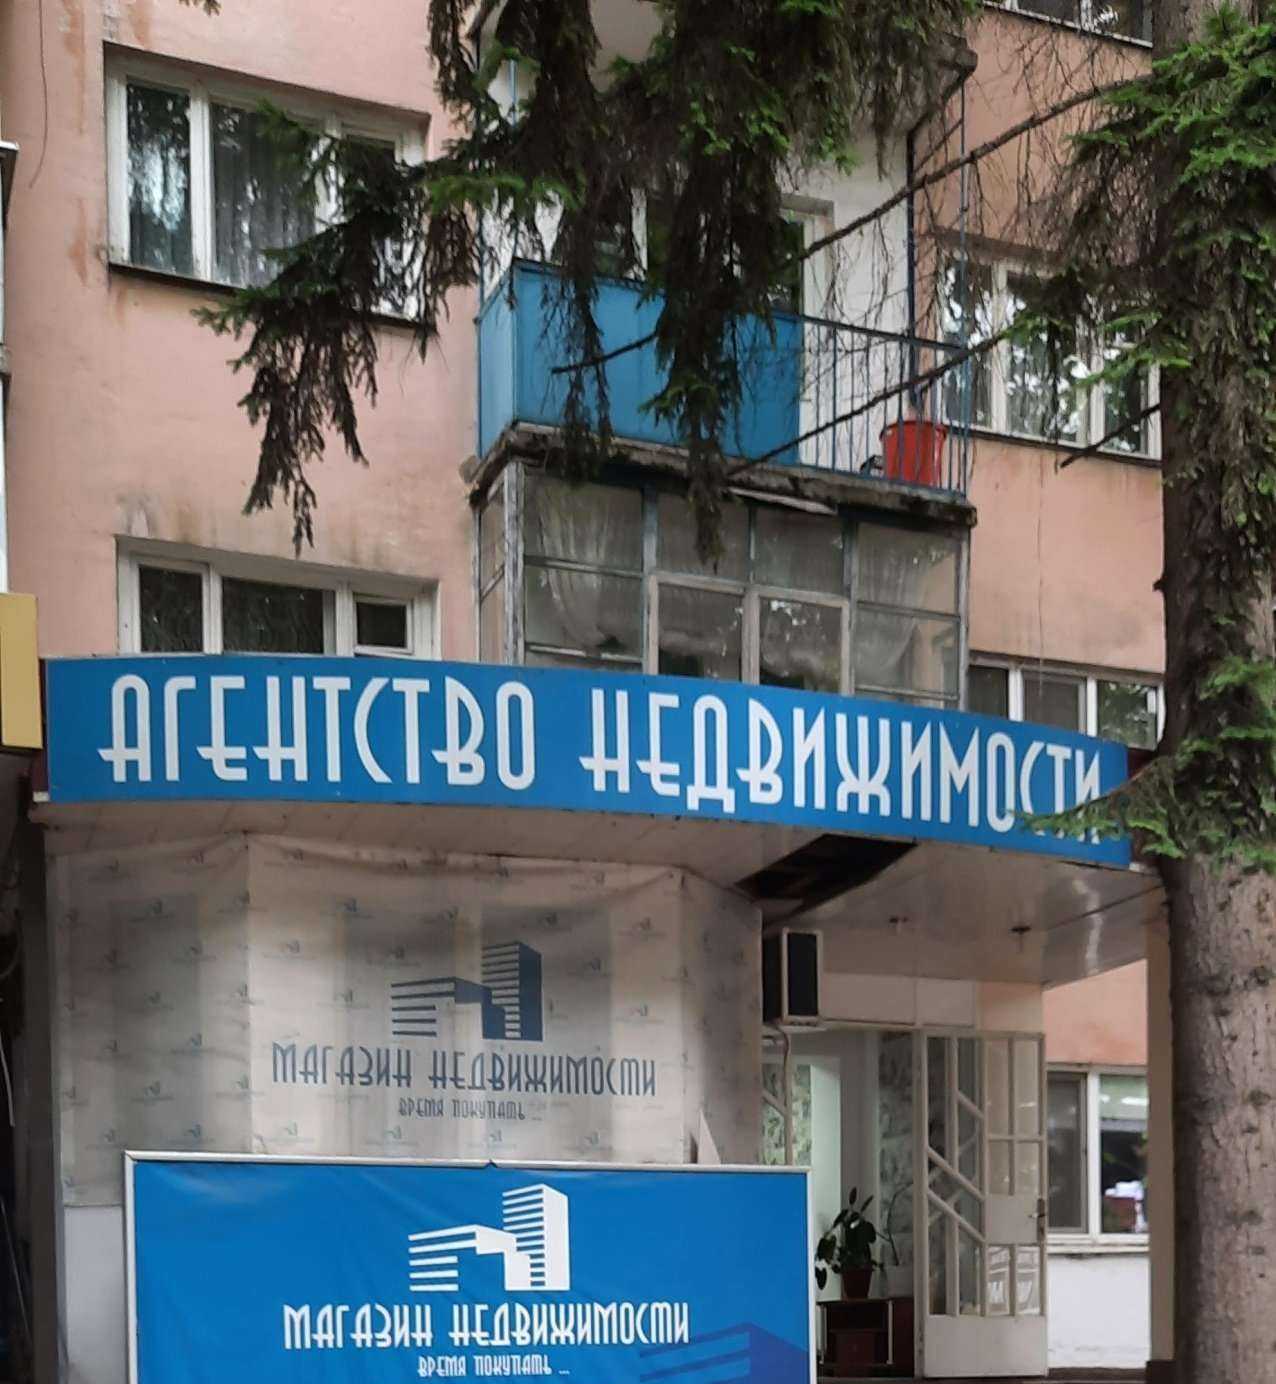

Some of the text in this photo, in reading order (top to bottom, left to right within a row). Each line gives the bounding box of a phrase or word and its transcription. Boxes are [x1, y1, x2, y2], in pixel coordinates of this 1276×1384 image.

[98, 674, 1100, 845] АГЕНТСТВО НЕДВИЖИМОСТИ
[272, 1041, 656, 1096] МАГАЗИН НЕДВИЖИМОСТИ
[399, 1097, 526, 1120] ВРЕМЯ ПОКУПАТЬ
[283, 1302, 689, 1349] МАГАЗИН НЕДВИЖИМОСТИ
[417, 1355, 466, 1377] ВРЕМЯ
[473, 1354, 552, 1376] ПОКУПАТЬ
